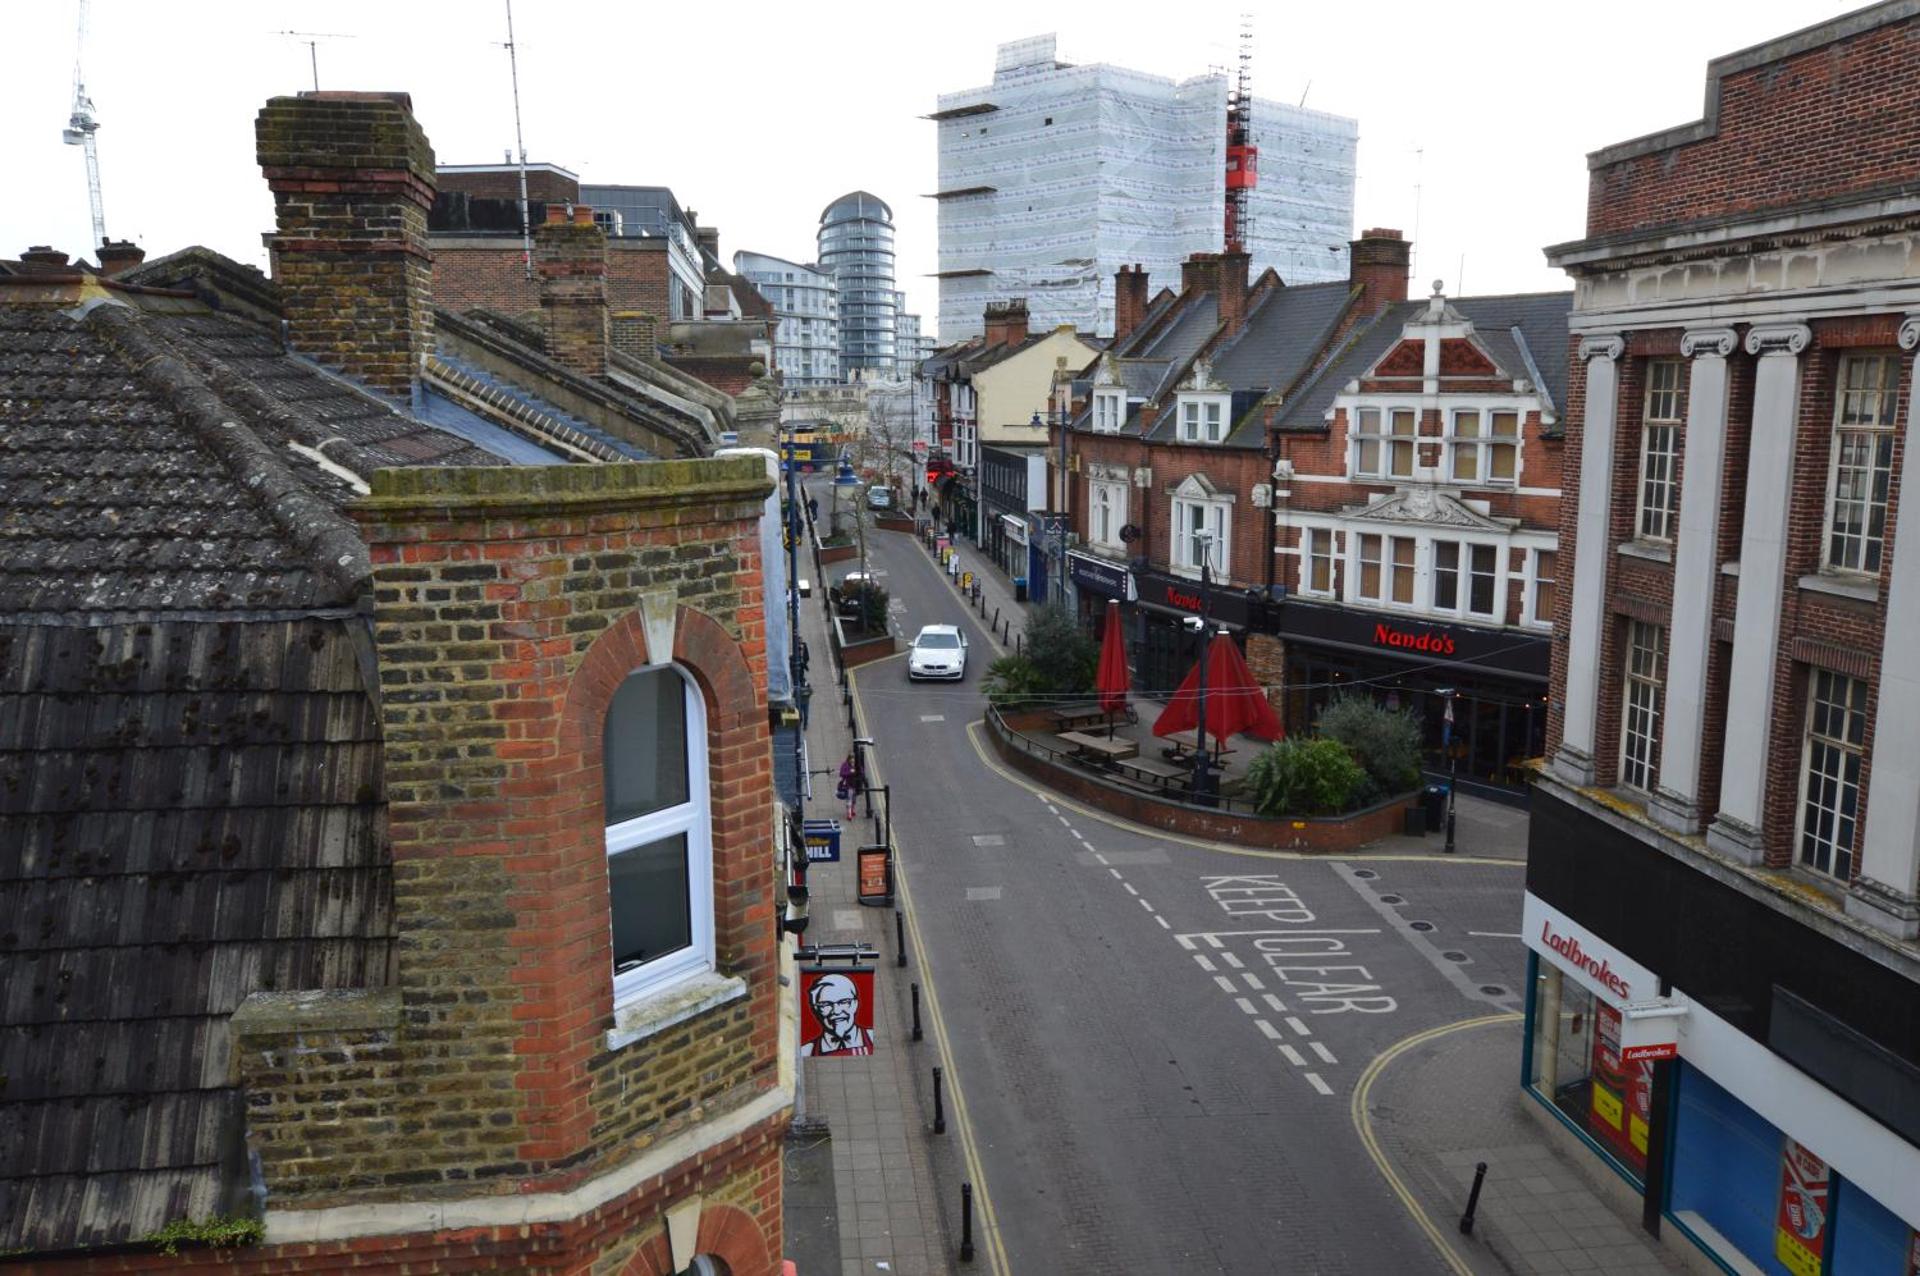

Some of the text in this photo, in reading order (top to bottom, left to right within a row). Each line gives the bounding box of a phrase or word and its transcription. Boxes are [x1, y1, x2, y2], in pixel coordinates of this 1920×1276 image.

[1373, 623, 1456, 655] Nando's
[1200, 874, 1316, 923] KEEP
[1253, 937, 1398, 1014] CLEAR
[1541, 920, 1631, 1000] Ladbrokes
[1627, 1047, 1671, 1060] Ladbrokes
